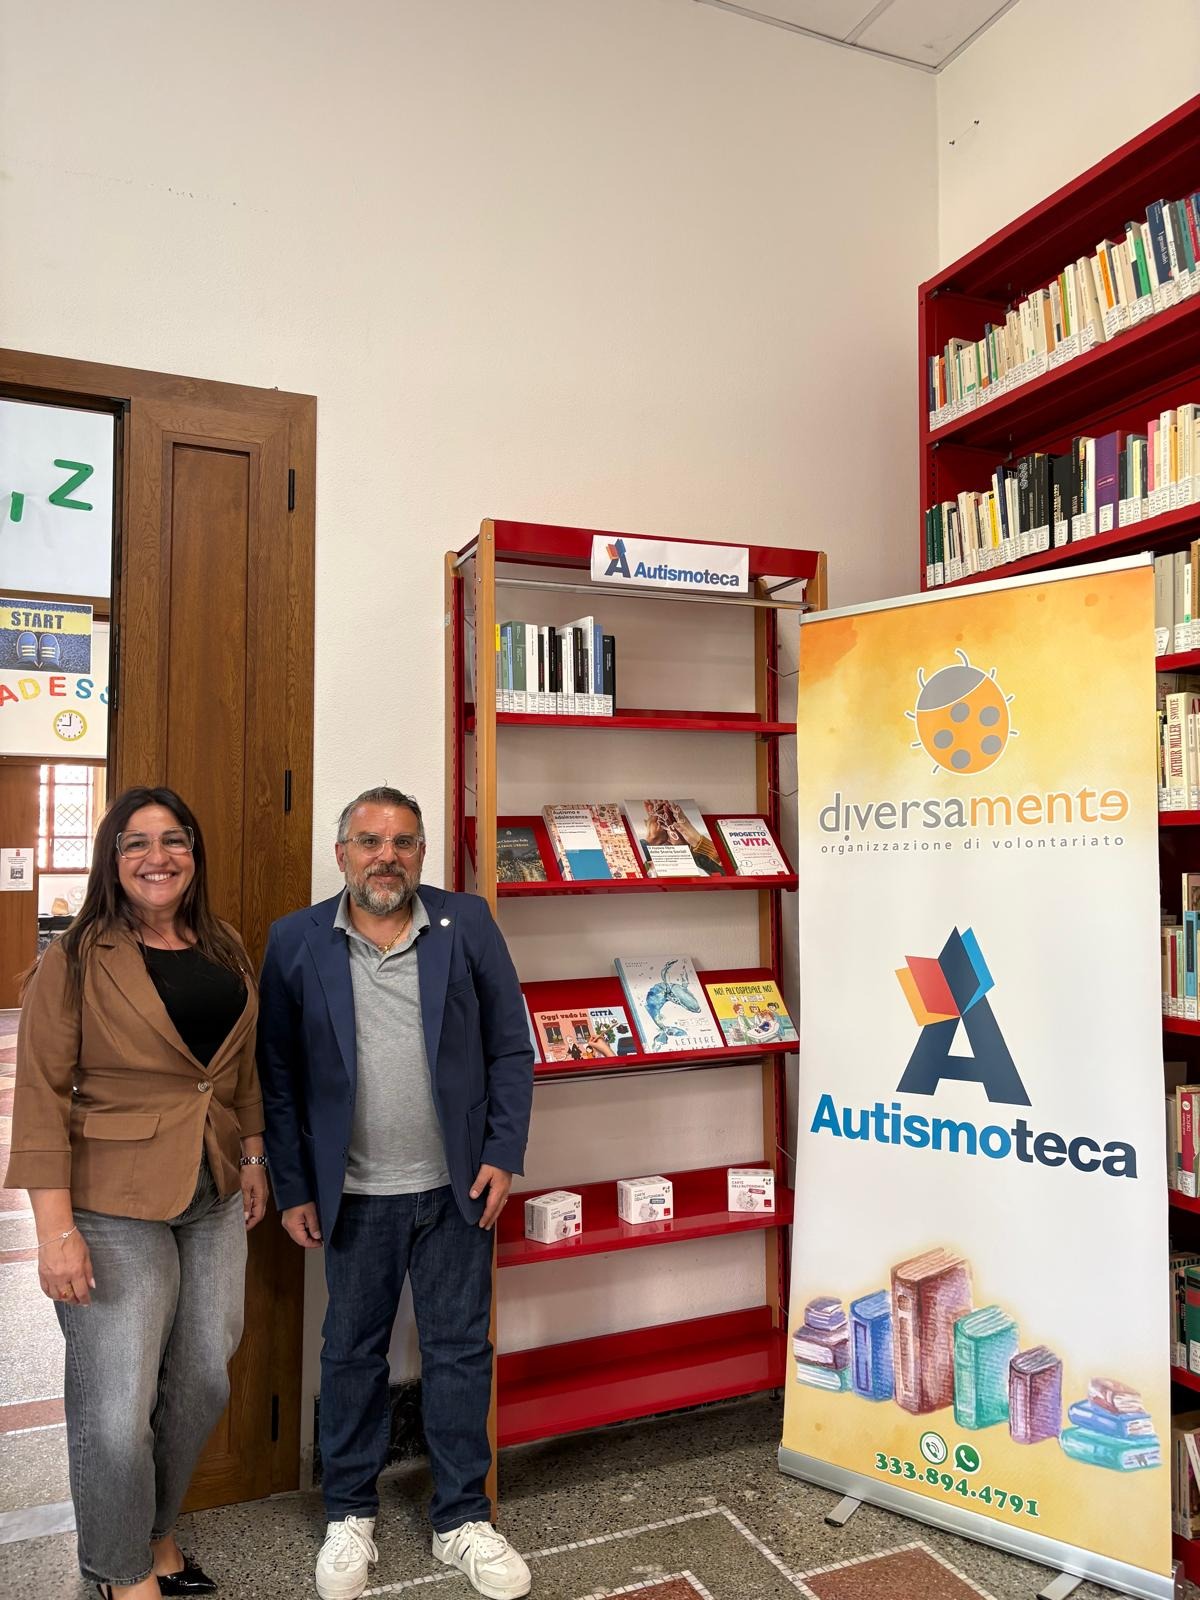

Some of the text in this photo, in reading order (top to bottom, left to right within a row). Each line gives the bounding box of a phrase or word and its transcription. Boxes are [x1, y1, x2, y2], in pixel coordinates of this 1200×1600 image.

[633, 561, 740, 587] Autismoteca
[11, 611, 65, 630] START
[1169, 723, 1182, 749] MILLER
[1170, 749, 1183, 778] ARTHUR
[819, 787, 1129, 842] diversamente
[740, 838, 771, 846] VITA
[821, 835, 1124, 855] organizzazione di volontariato
[540, 1013, 559, 1021] Oggi
[590, 1008, 614, 1017] CITTÀ
[810, 1093, 1138, 1179] Autismoteca
[875, 1453, 1040, 1517] 333.894.4791
